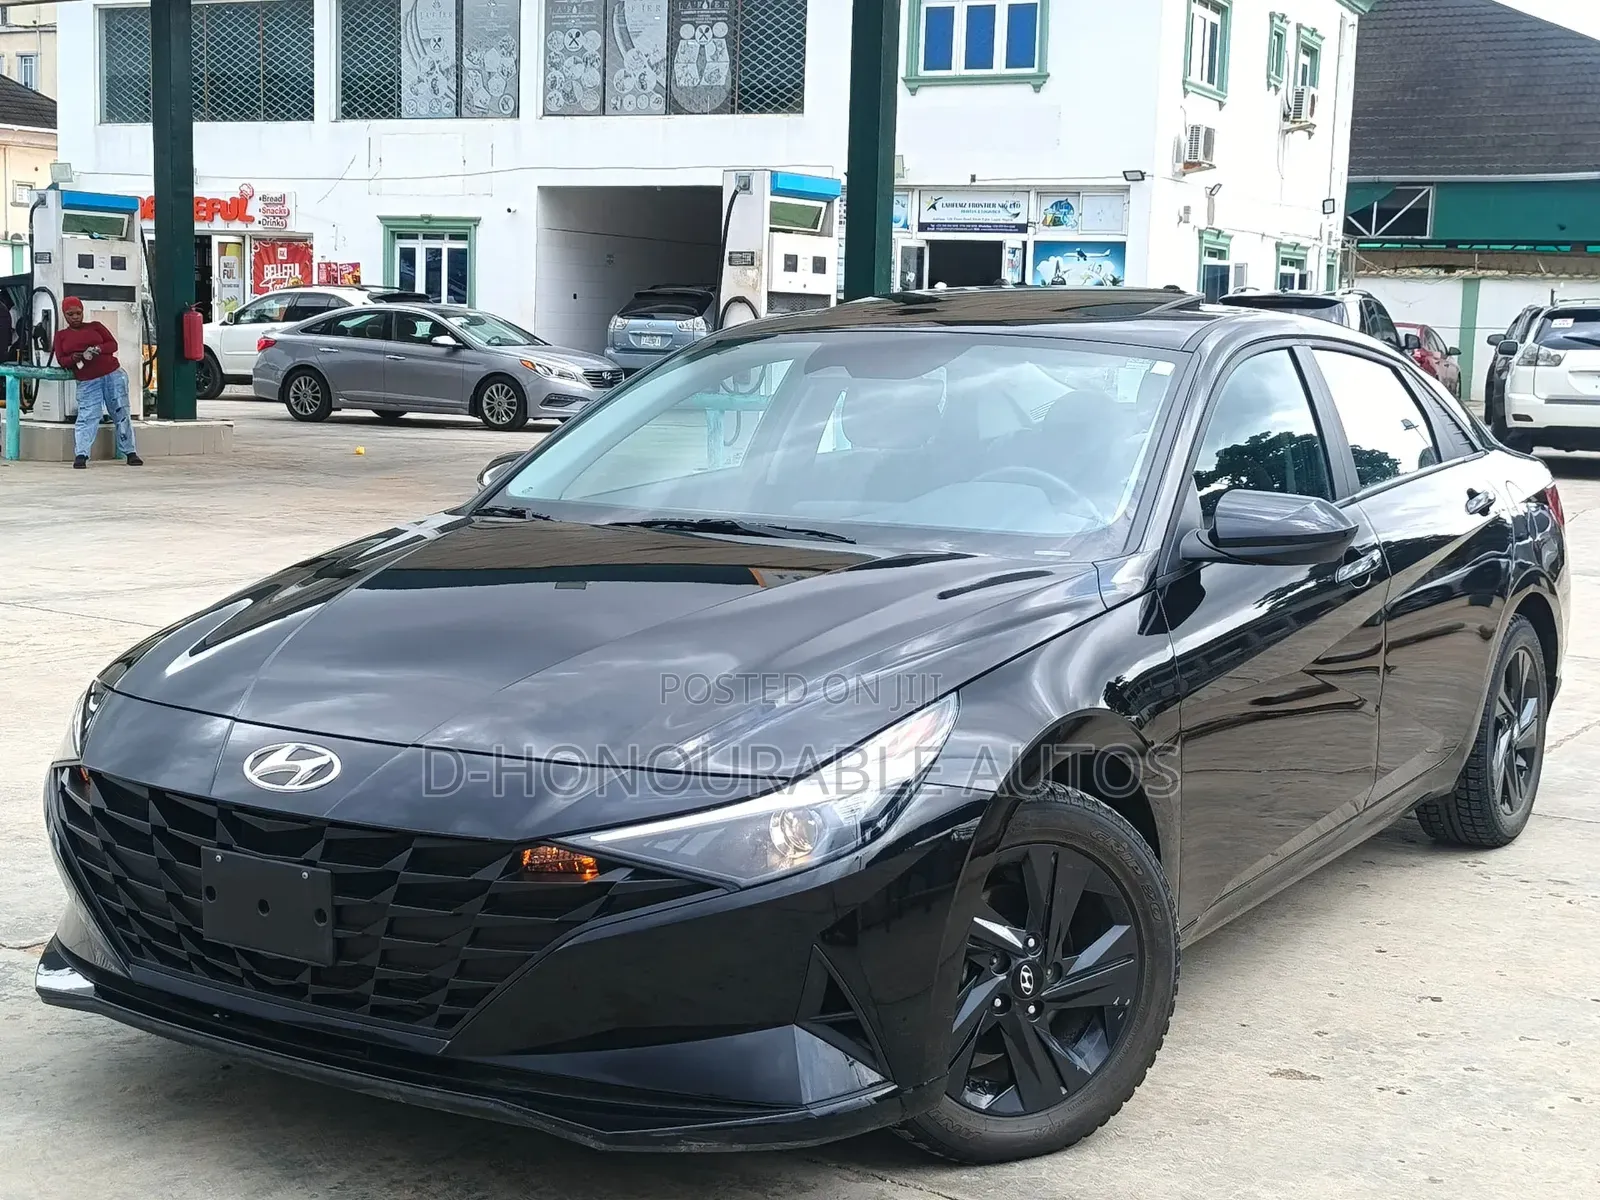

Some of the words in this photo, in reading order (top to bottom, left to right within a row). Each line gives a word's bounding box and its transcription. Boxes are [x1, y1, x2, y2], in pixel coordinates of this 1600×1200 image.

[261, 194, 283, 203] Bread
[261, 204, 287, 215] Snacks
[261, 218, 285, 228] Drinks
